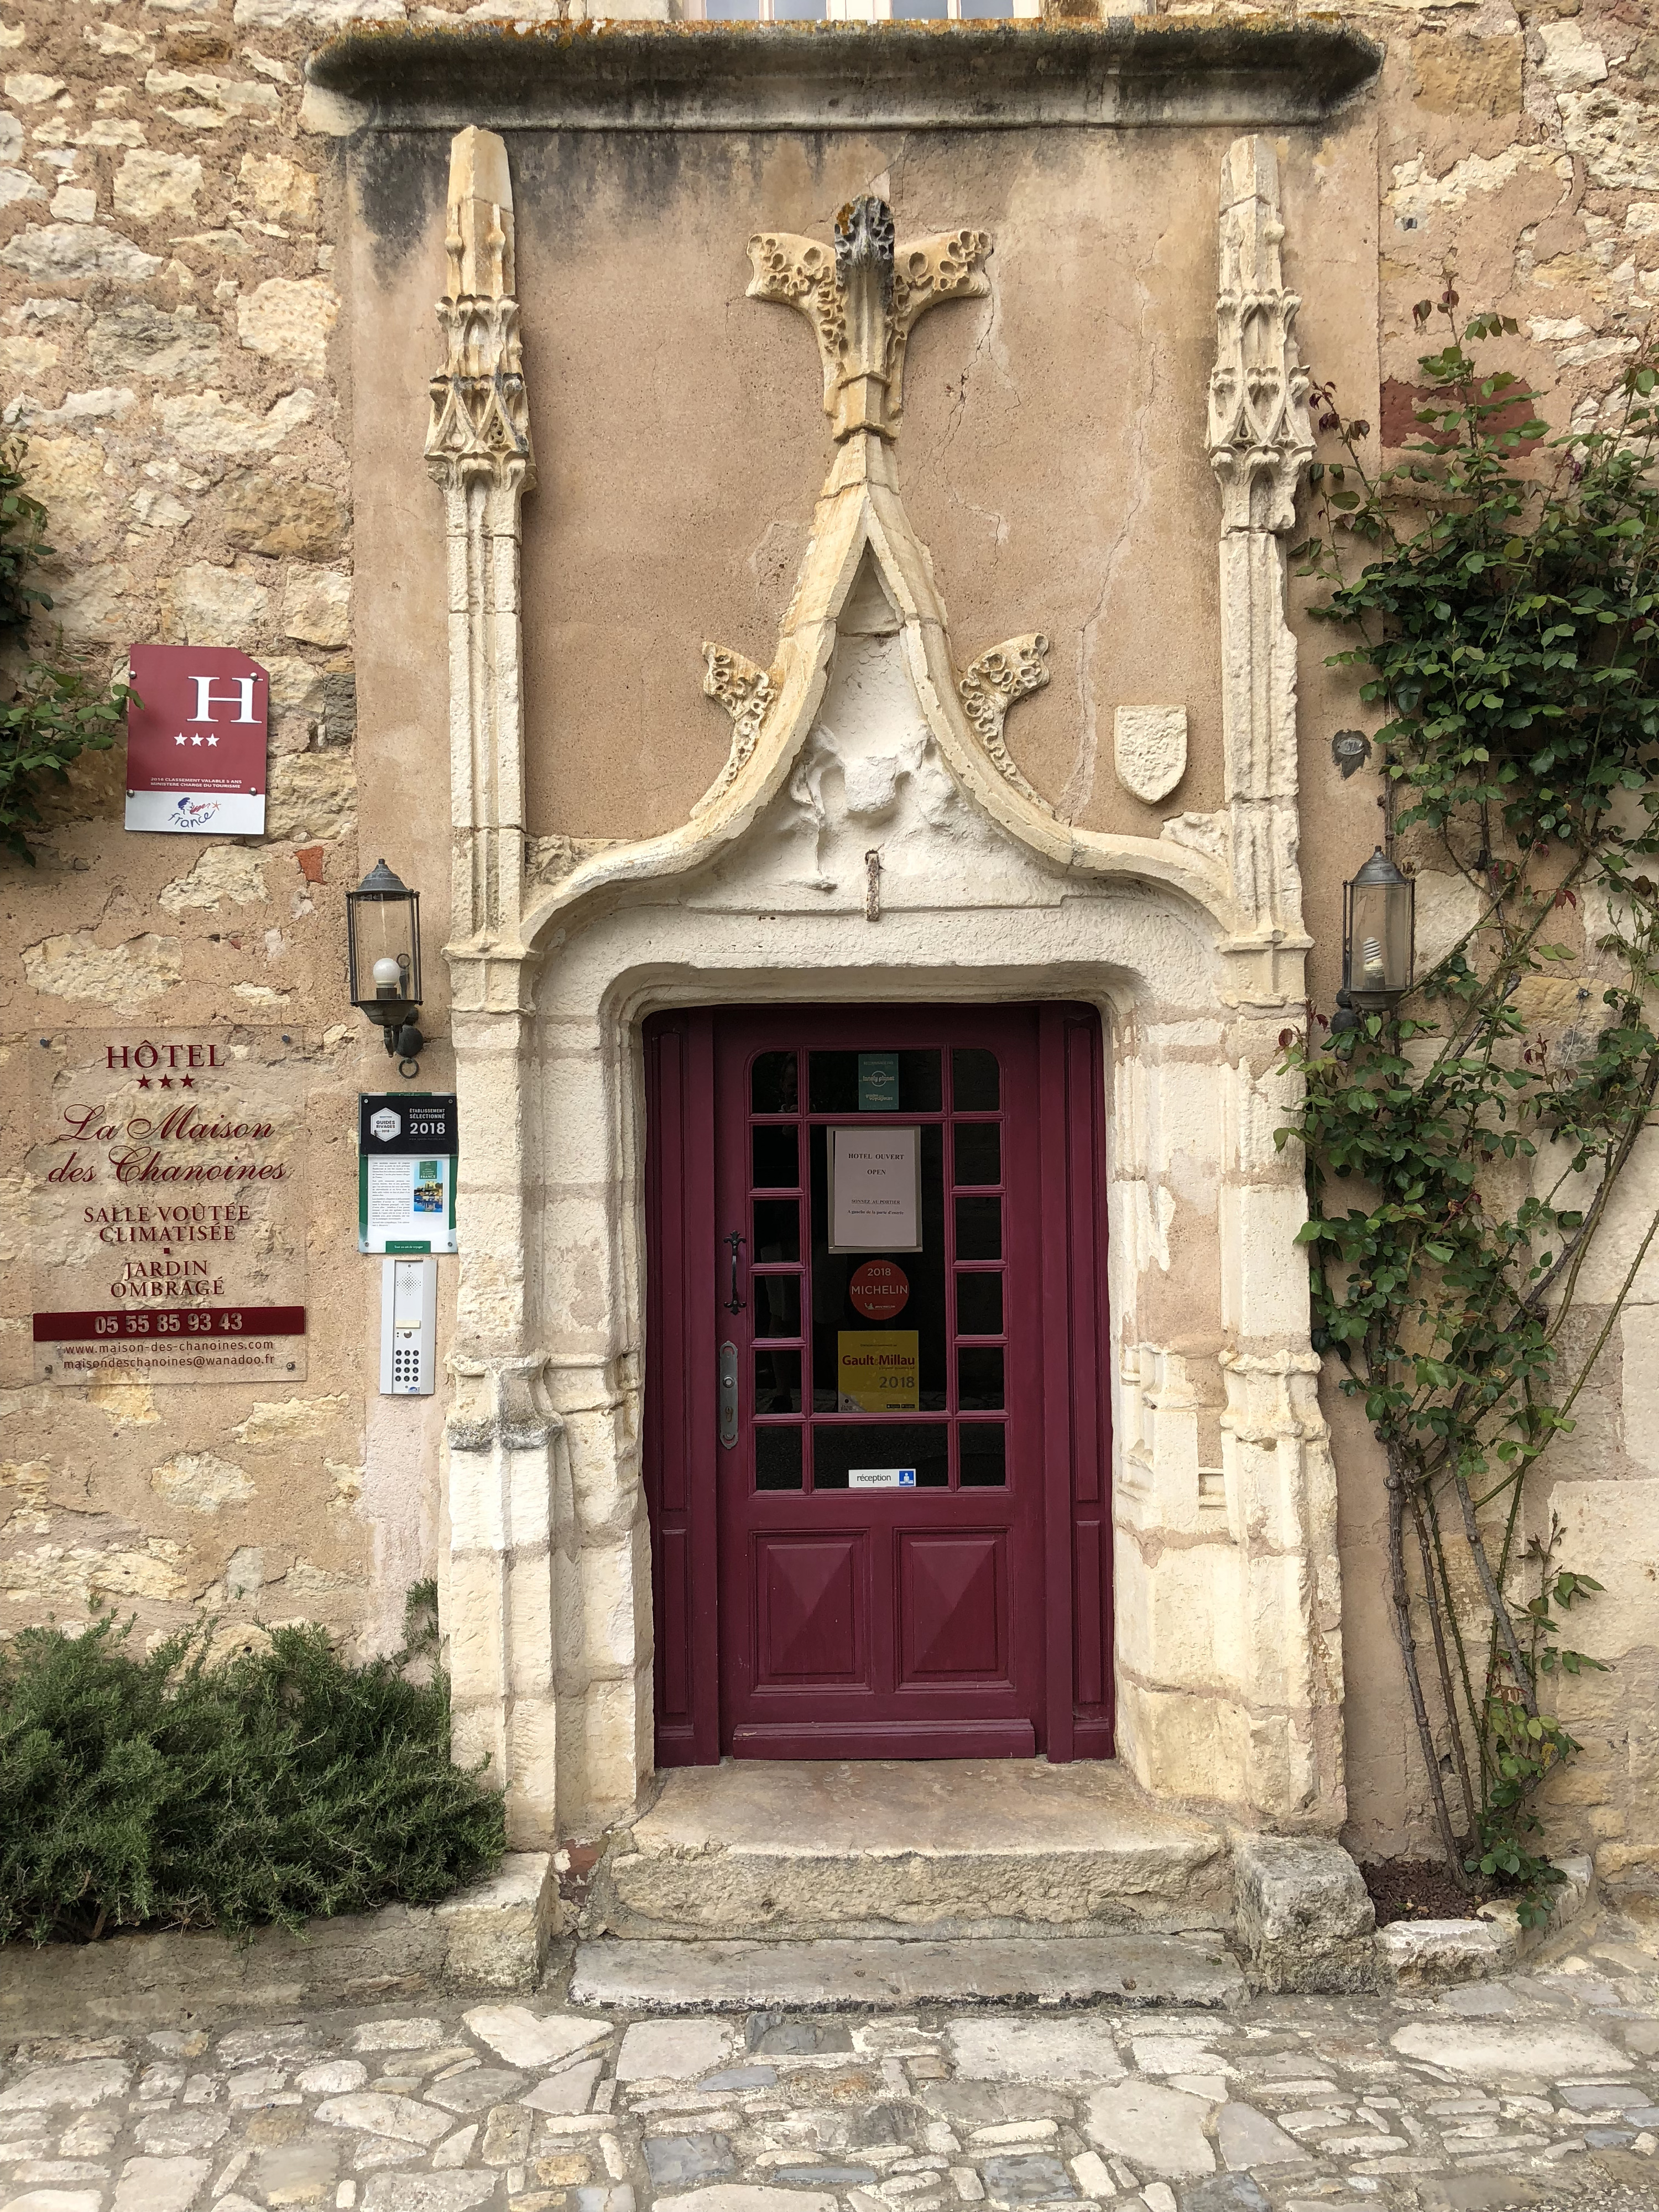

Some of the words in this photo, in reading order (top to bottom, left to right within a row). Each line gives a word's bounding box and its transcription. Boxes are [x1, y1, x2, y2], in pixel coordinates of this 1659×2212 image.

[187, 676, 263, 723] H
[168, 810, 216, 828] france
[105, 1039, 225, 1069] HÔTEL
[58, 1104, 118, 1141] La
[127, 1104, 275, 1140] Maison
[409, 1122, 446, 1135] 2018
[48, 1152, 96, 1183] des
[108, 1145, 286, 1187] Chanoines
[84, 1206, 150, 1223] SALLE
[157, 1202, 251, 1222] VOÛTÉE
[99, 1222, 236, 1243] CLIMATISÉE
[124, 1260, 208, 1281] JARDIN
[867, 1268, 891, 1276] 2018
[111, 1276, 225, 1298] OMBRAGÉ
[852, 1285, 907, 1295] MICHELIN
[95, 1316, 118, 1334] 05
[126, 1314, 149, 1333] 55
[156, 1313, 180, 1332] 85
[187, 1313, 212, 1331] 93
[218, 1312, 243, 1331] 43
[65, 1339, 273, 1354] www.maison-des-chanoines.com
[64, 1353, 275, 1370] maisondeschanoines@wanadoo.fr
[879, 1376, 915, 1388] 2018
[857, 1474, 891, 1483] réception
